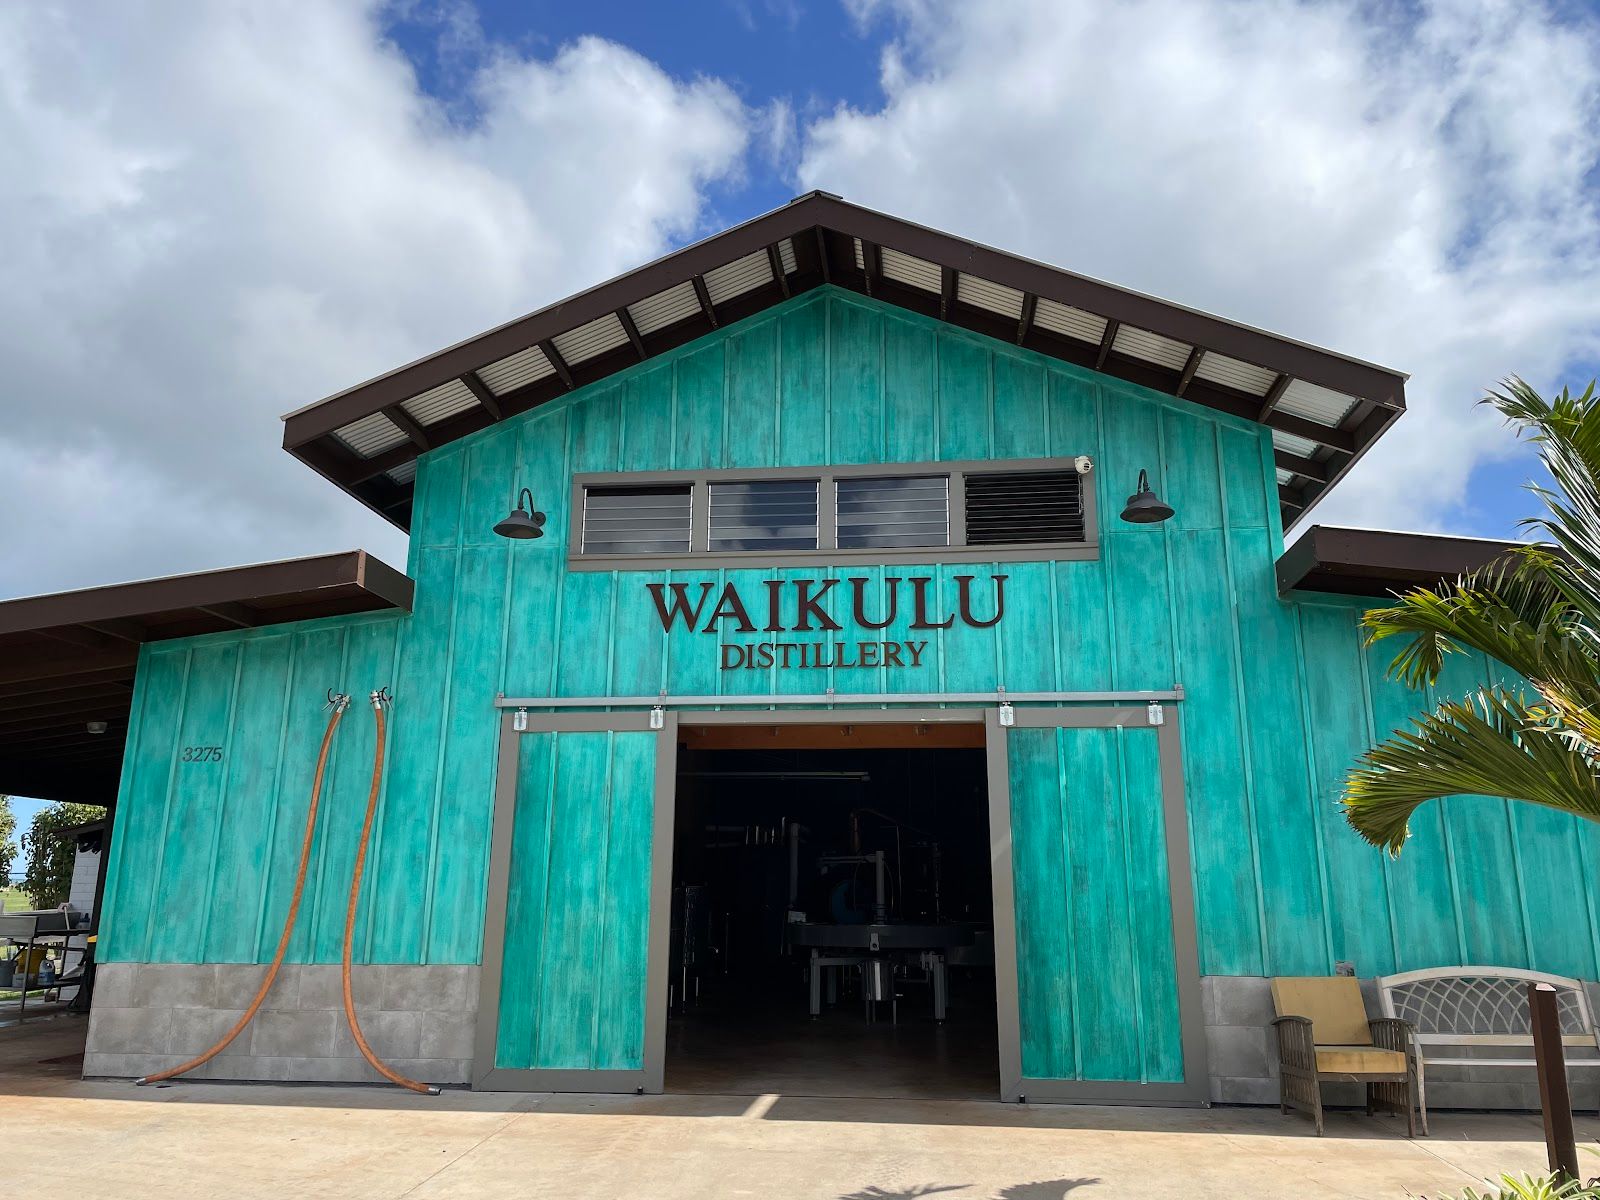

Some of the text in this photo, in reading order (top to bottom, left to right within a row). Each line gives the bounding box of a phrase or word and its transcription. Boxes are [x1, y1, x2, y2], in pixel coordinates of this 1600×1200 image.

[645, 575, 1009, 634] WAIKULU
[720, 641, 928, 670] DISTILLERY
[182, 746, 223, 762] 3275
